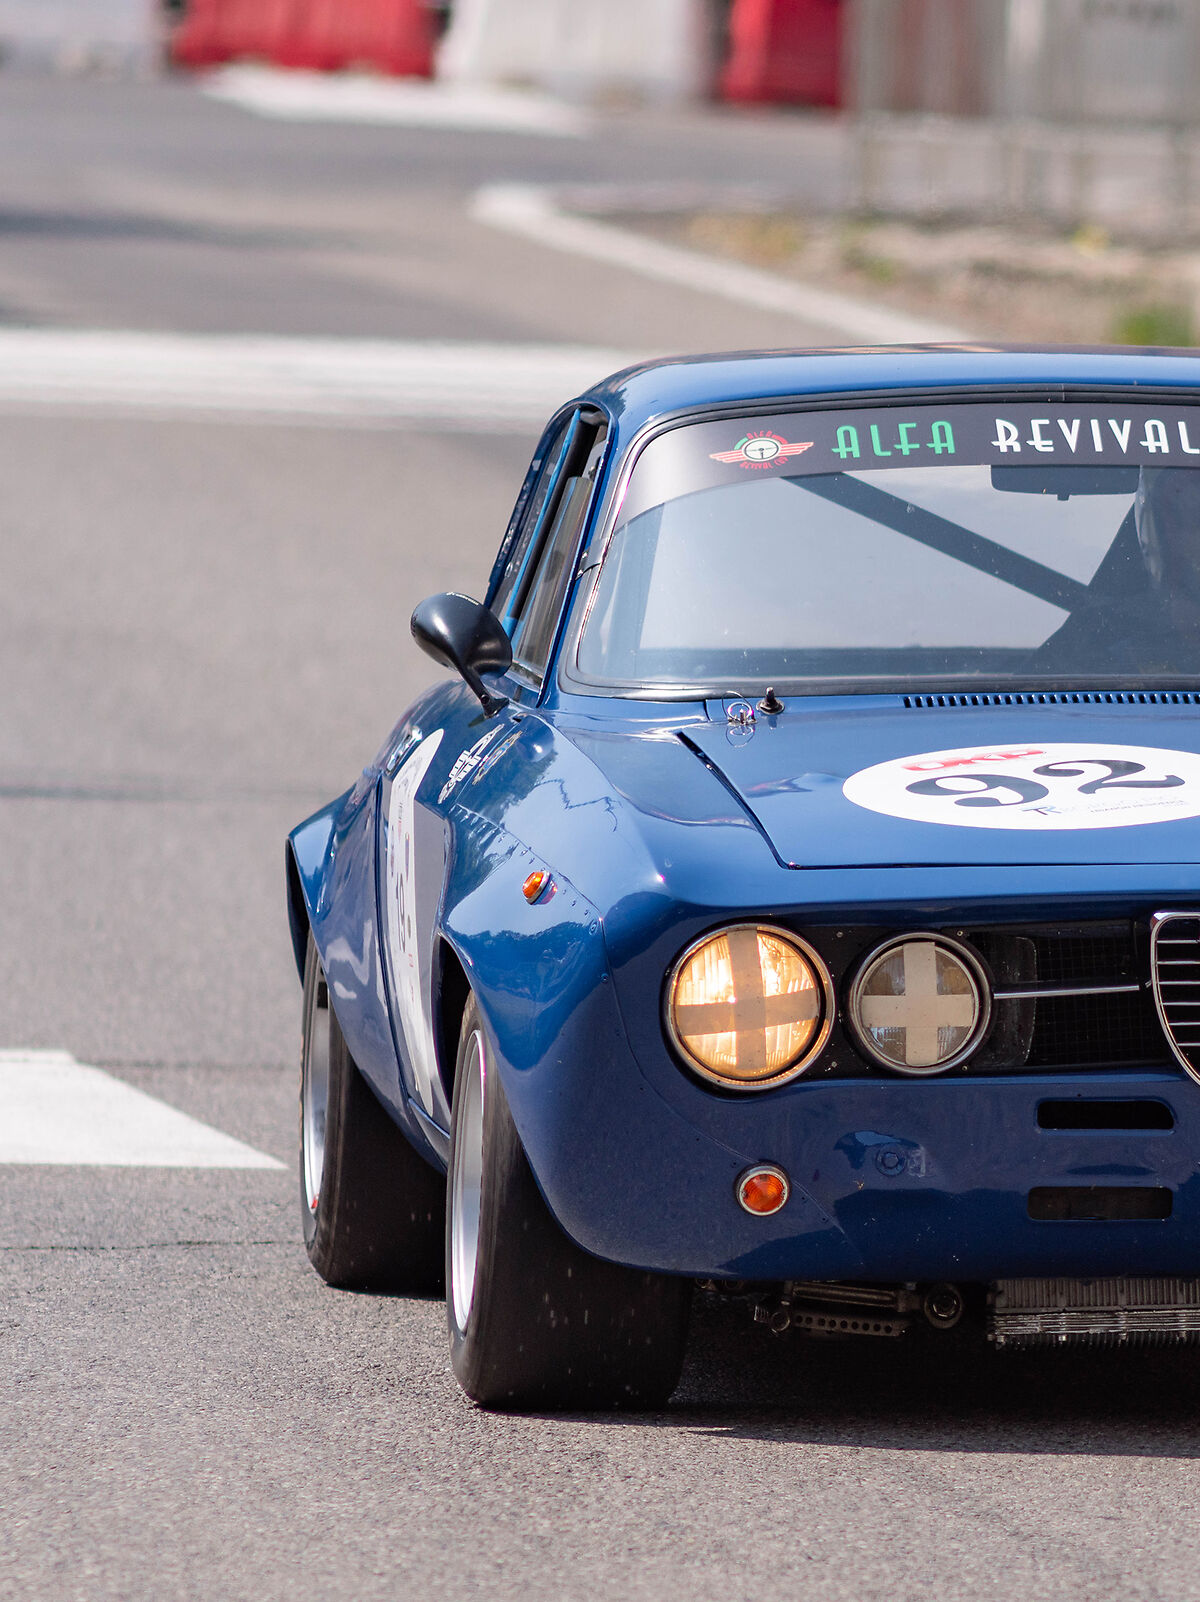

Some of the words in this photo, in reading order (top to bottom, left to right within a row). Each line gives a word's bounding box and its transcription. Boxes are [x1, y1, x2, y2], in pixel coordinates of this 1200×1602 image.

[831, 420, 956, 459] ALFA
[991, 418, 1200, 454] REVIVAL
[905, 759, 1186, 807] 92
